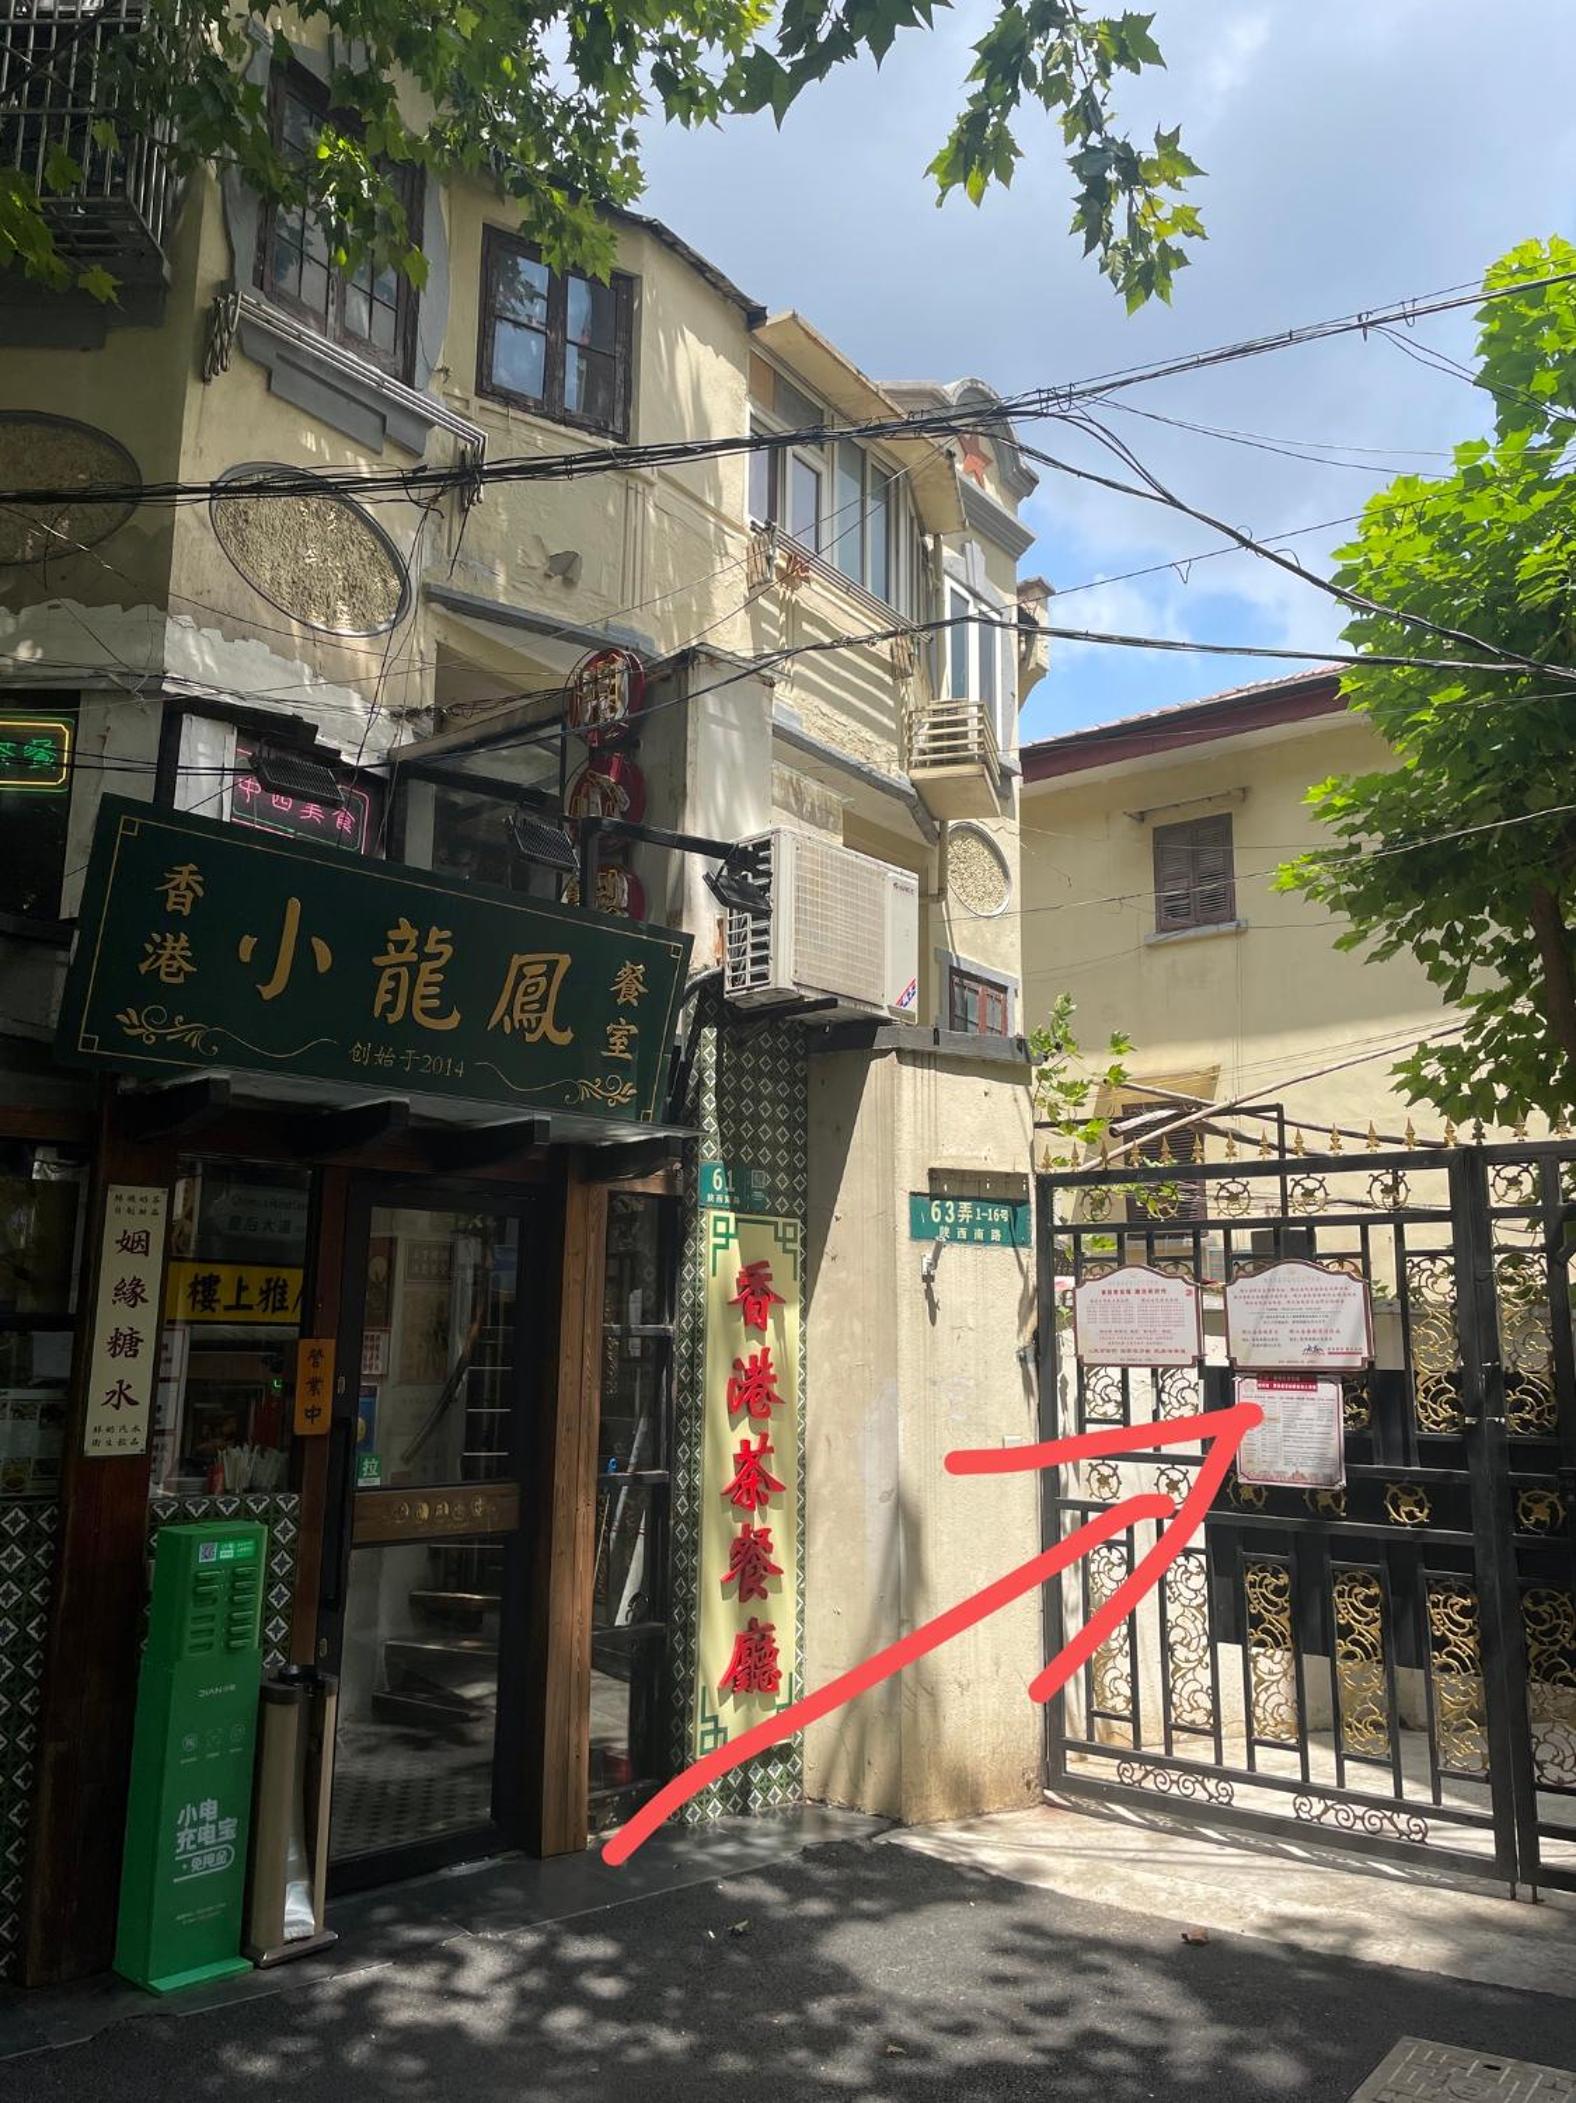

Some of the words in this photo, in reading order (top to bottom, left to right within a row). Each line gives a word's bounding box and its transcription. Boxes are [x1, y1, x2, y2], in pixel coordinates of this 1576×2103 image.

[237, 777, 357, 835] 中西美食
[138, 864, 205, 986] 香港
[238, 897, 574, 1046] 小龍鳳
[600, 960, 651, 1062] 餐室
[348, 1040, 466, 1079] 创始于2014
[712, 1168, 736, 1193] 61
[187, 1272, 303, 1314] 樓上雅
[101, 1229, 151, 1412] 姻緣糖水
[362, 1457, 379, 1477] 拉
[718, 1259, 787, 1694] 香港茶餐廳
[175, 1816, 239, 1854] 充电宝
[176, 1798, 219, 1827] 小电
